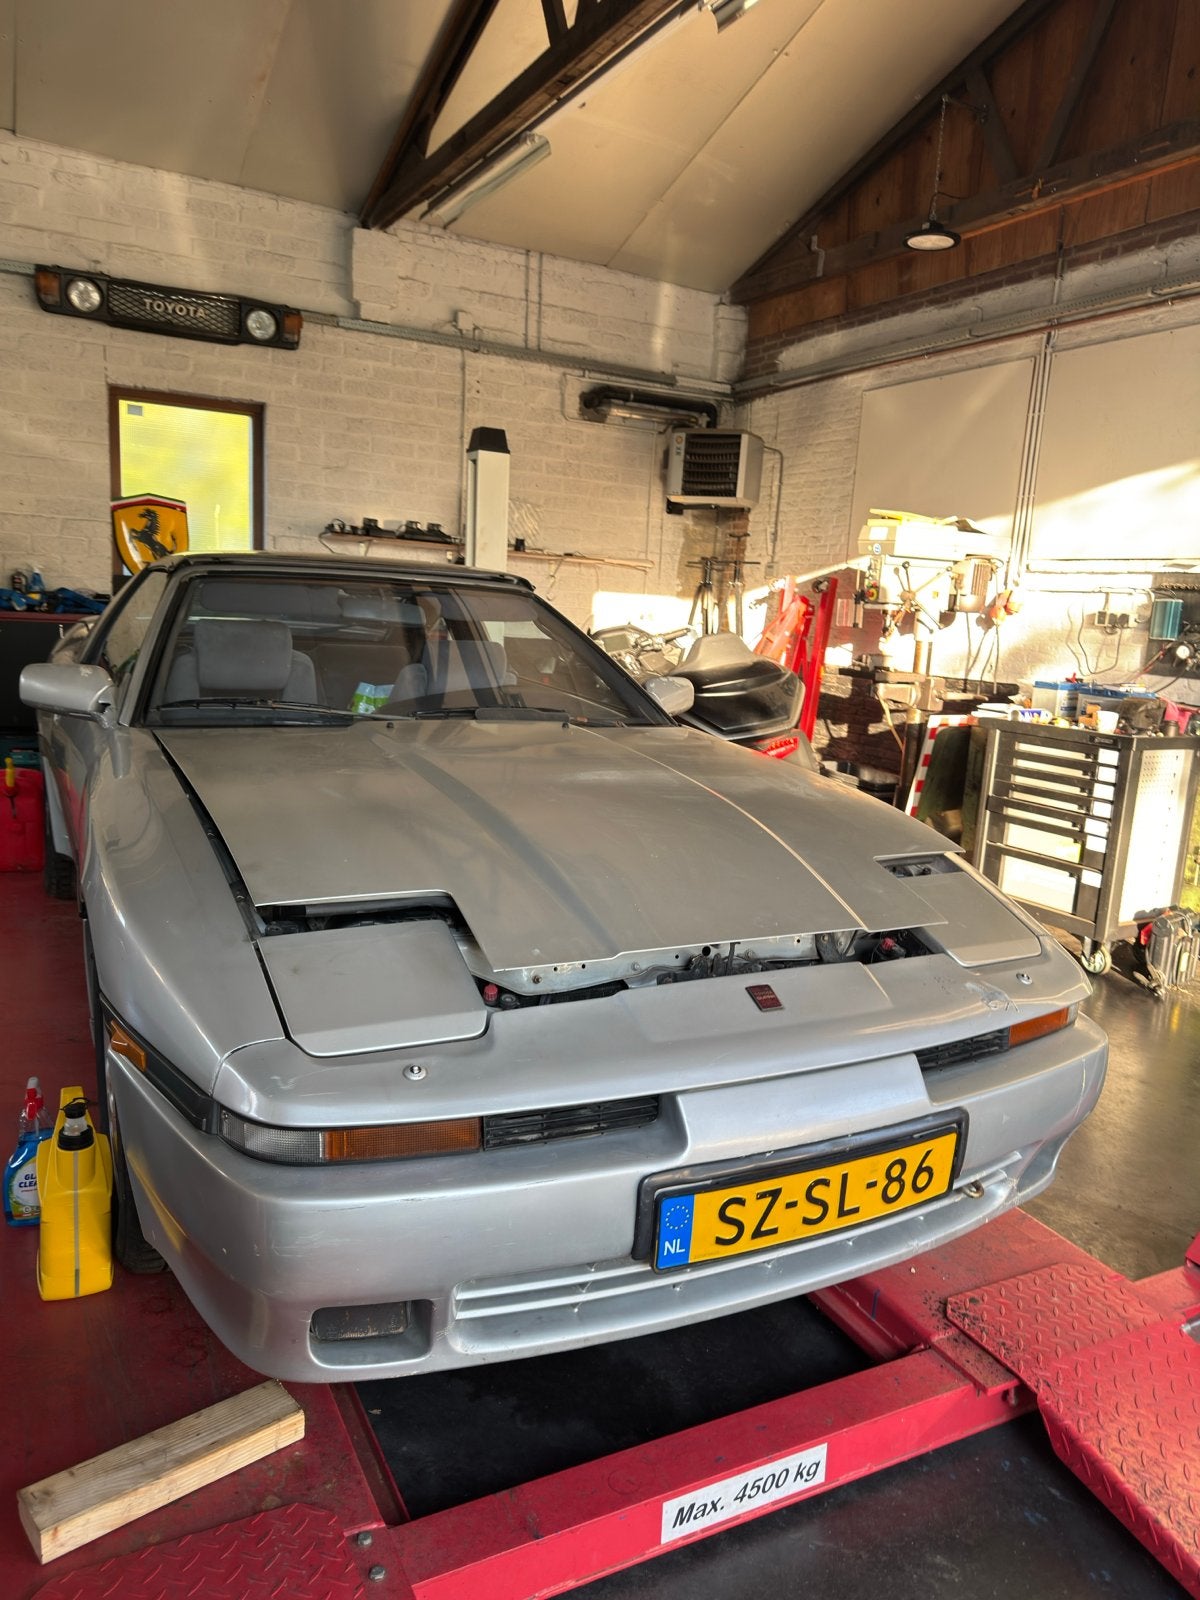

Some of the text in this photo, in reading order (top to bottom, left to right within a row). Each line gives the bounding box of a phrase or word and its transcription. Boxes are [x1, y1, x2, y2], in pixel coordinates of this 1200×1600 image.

[143, 298, 207, 319] TOYOTA
[18, 1180, 37, 1188] CLEA
[24, 1173, 37, 1181] GL
[714, 1149, 934, 1245] SZ-SL-86
[663, 1239, 686, 1256] NL
[672, 1460, 821, 1529] Max. 4500 kg
